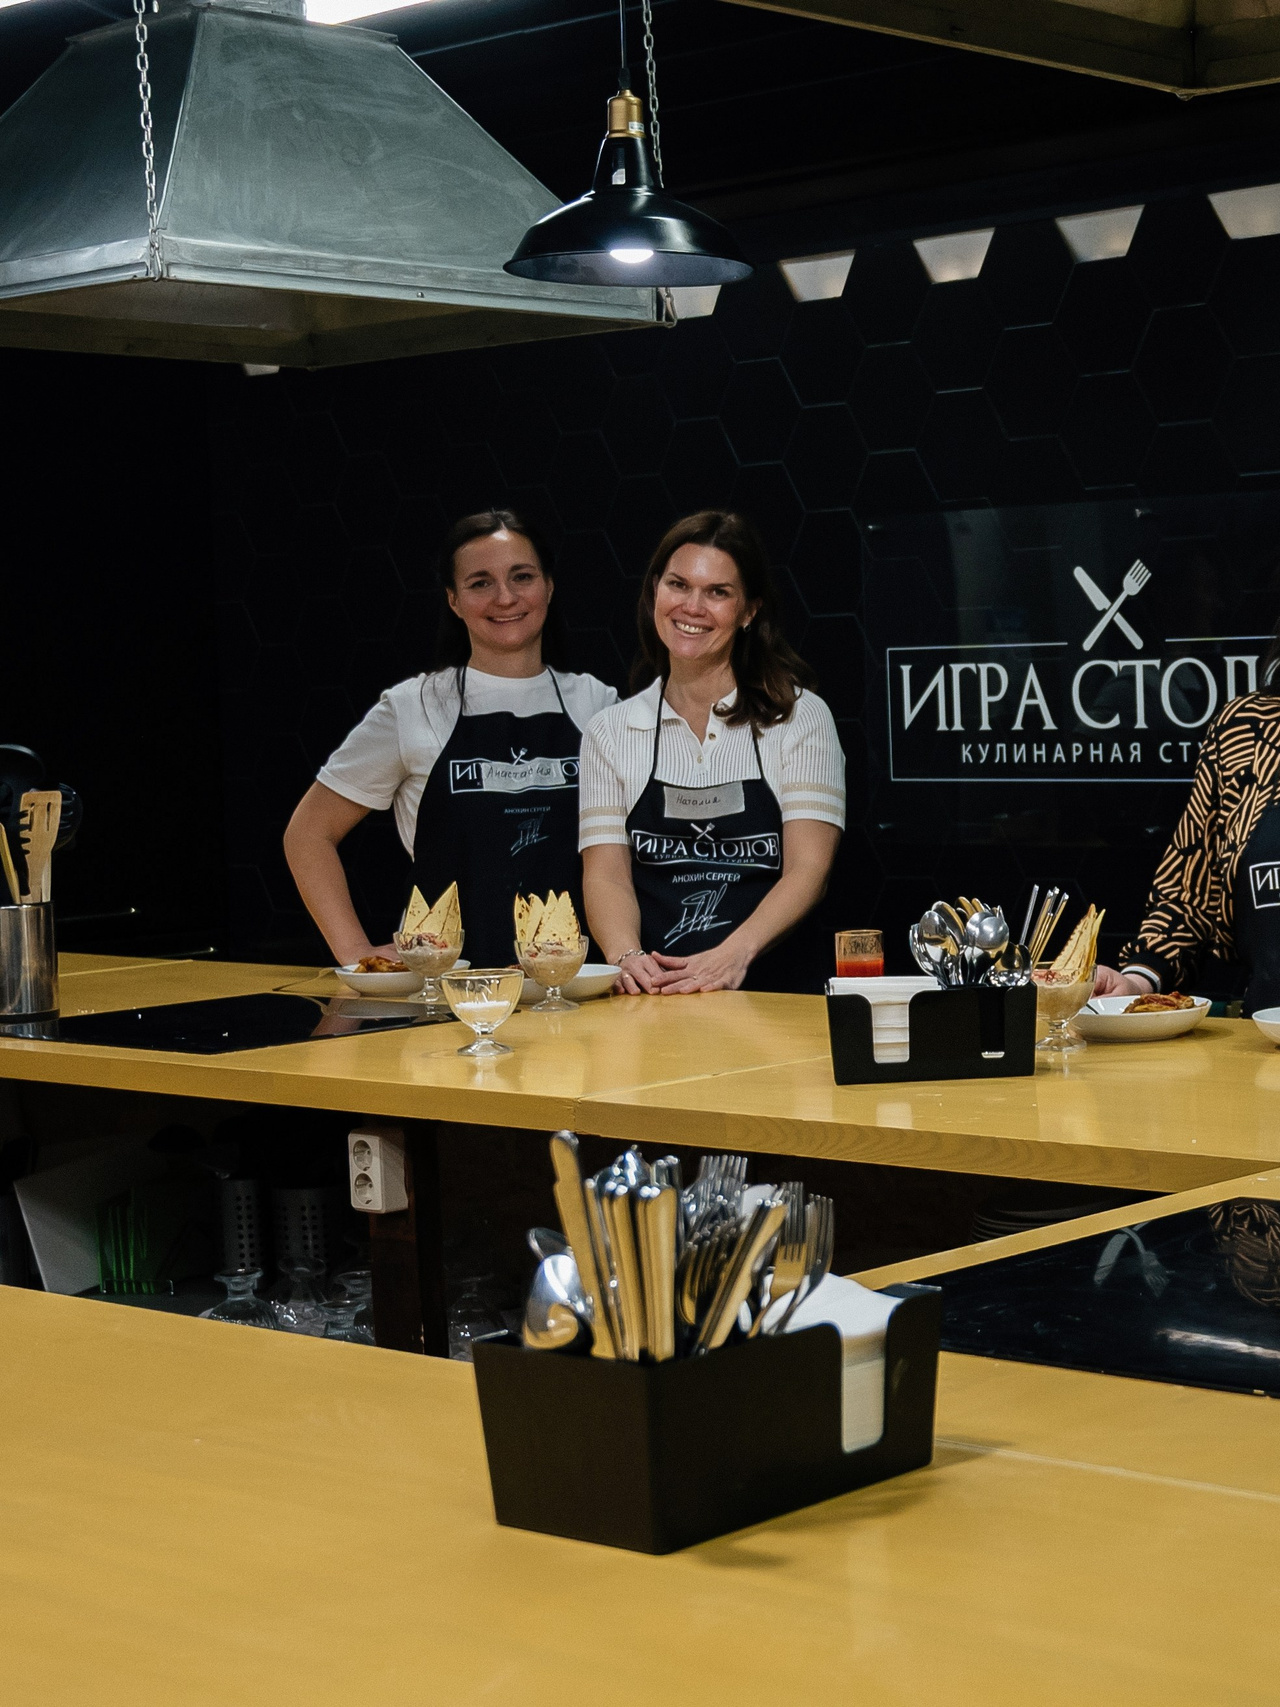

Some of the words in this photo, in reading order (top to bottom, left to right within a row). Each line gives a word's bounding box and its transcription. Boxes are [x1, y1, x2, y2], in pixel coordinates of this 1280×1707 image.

[900, 662, 1058, 731] ИГРА
[962, 742, 1141, 764] КУЛИНАРНАЯ
[676, 795, 721, 806] Наталия
[636, 835, 688, 857] ИГРА
[694, 837, 778, 858] СТОЛОВ
[672, 871, 705, 884] АНОХИН
[706, 871, 741, 883] СЕРГЕЙ
